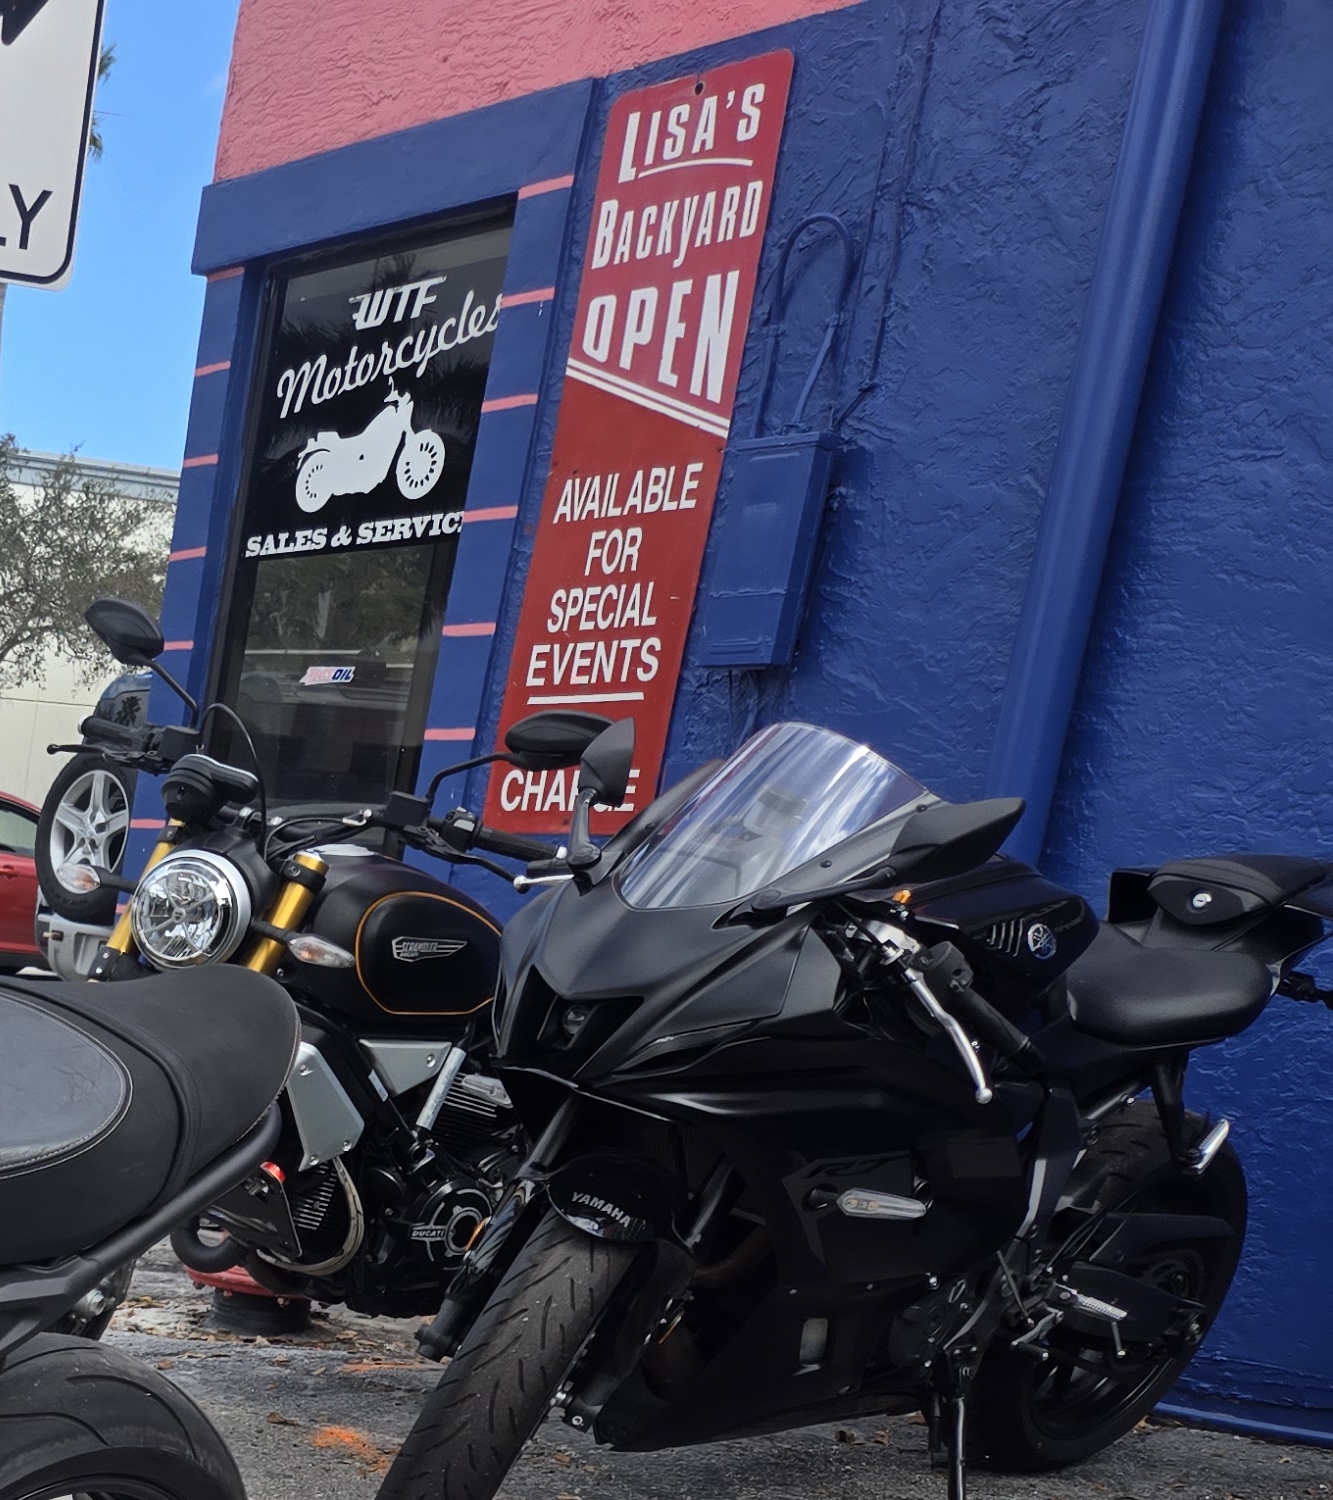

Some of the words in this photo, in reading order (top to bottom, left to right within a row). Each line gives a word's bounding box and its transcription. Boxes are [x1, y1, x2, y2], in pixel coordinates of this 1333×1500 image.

[618, 83, 766, 183] LISA'S
[591, 180, 763, 269] BACKYARD
[348, 276, 448, 330] WTF
[582, 270, 740, 404] OPEN
[553, 462, 704, 523] AVAILABLE
[245, 525, 328, 557] SALES
[331, 528, 353, 547] &
[356, 510, 465, 545] SERVIC
[585, 527, 643, 576] FOR
[547, 582, 658, 633] SPECIAL
[526, 637, 662, 687] EVENTS
[501, 769, 641, 812] CHAE
[412, 1229, 445, 1238] DUCATI
[571, 1191, 631, 1228] YAMAHA
